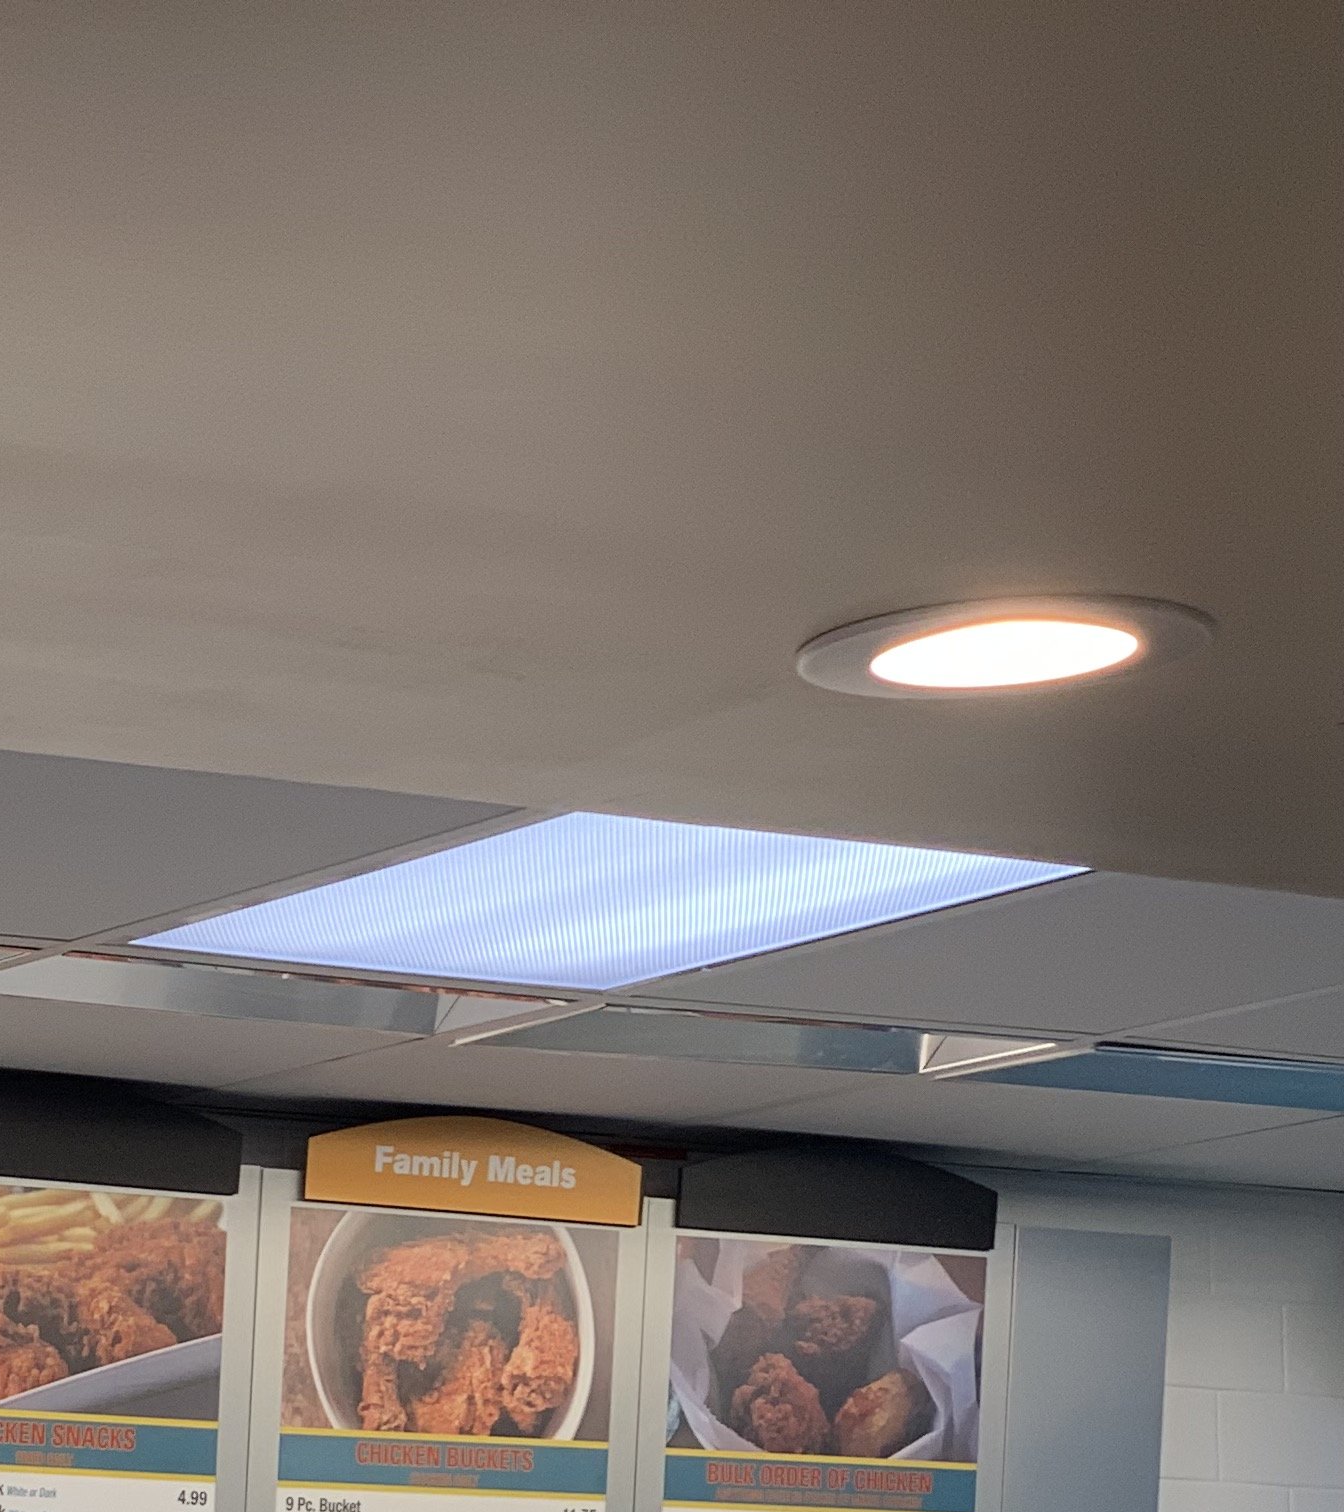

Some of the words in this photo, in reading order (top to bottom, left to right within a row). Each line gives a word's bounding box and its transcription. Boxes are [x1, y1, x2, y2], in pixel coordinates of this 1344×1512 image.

[374, 1145, 478, 1186] Family
[487, 1155, 576, 1189] Meals
[52, 1423, 134, 1450] SNACKS
[356, 1442, 440, 1466] CHICKEN
[445, 1446, 531, 1470] BUCKETS
[707, 1462, 753, 1485] BULK
[760, 1465, 821, 1487] ORDER
[827, 1468, 847, 1488] OF
[855, 1470, 931, 1492] CHICKEN
[285, 1496, 294, 1511] 9
[297, 1496, 316, 1512] Pc.
